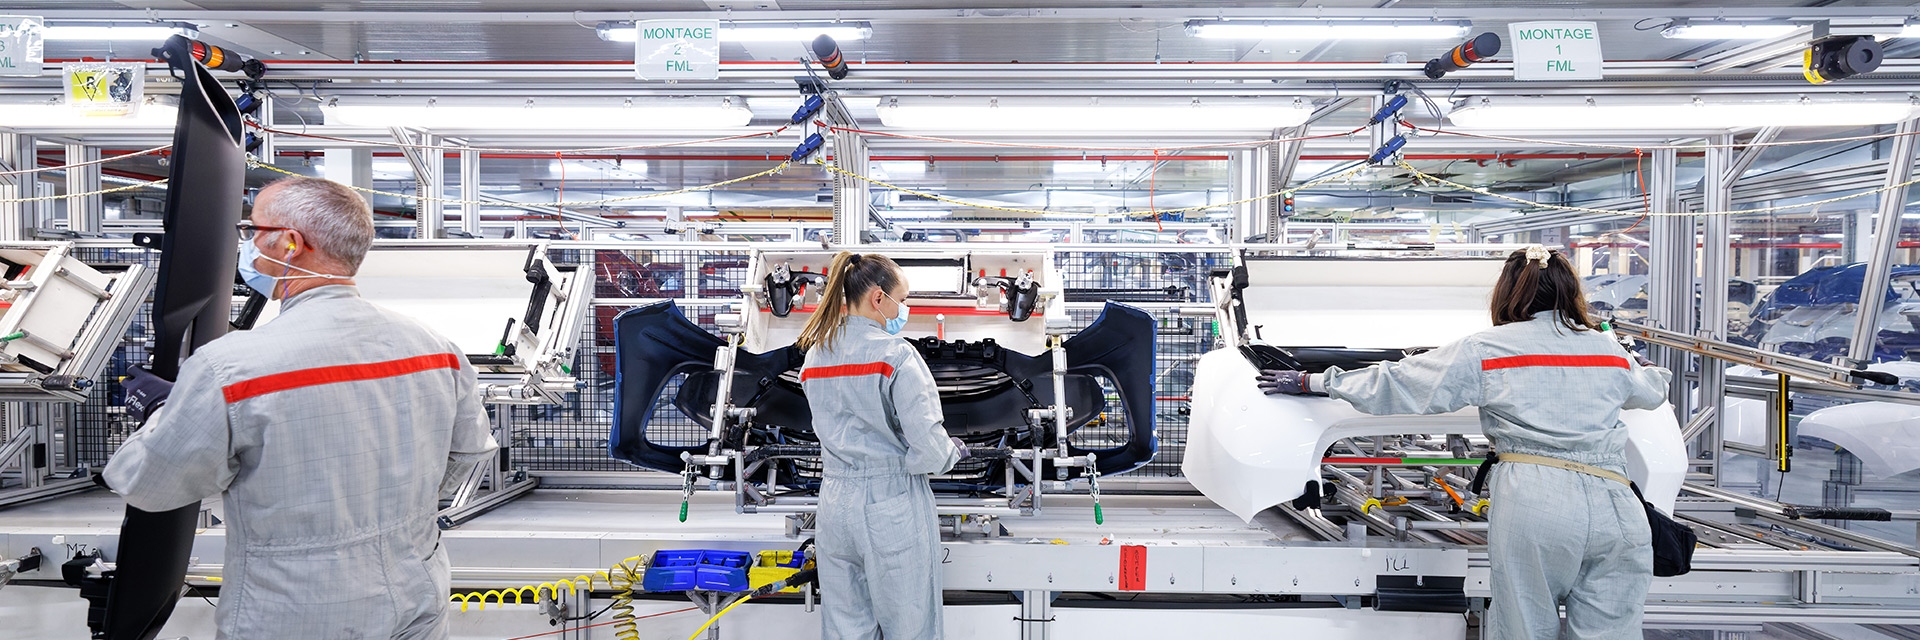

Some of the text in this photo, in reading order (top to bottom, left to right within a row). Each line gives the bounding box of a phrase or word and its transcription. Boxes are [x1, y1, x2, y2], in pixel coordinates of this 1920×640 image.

[643, 27, 713, 40] MONTAGE
[1519, 28, 1594, 40] MONTAGE
[673, 43, 682, 56] 2
[1555, 44, 1562, 55] 1
[666, 60, 694, 72] FML
[1546, 60, 1576, 72] FML
